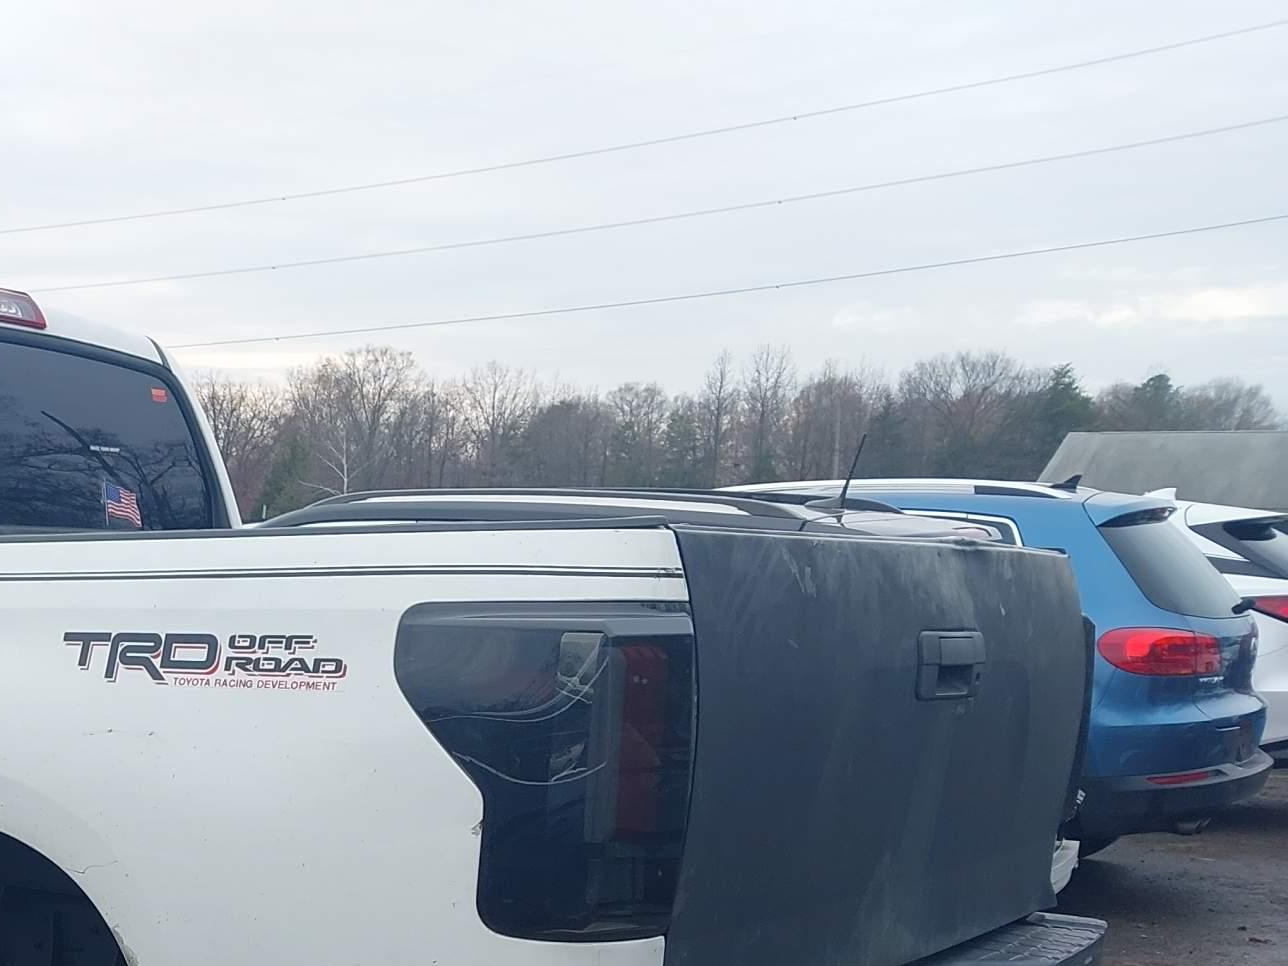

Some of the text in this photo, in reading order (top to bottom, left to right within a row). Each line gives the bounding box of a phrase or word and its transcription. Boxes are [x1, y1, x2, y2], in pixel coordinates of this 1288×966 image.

[228, 634, 318, 654] OFF
[63, 632, 222, 686] TRD
[224, 656, 348, 679] ROAD
[173, 677, 337, 691] TOYOTA RACING DEVELOPMENT
